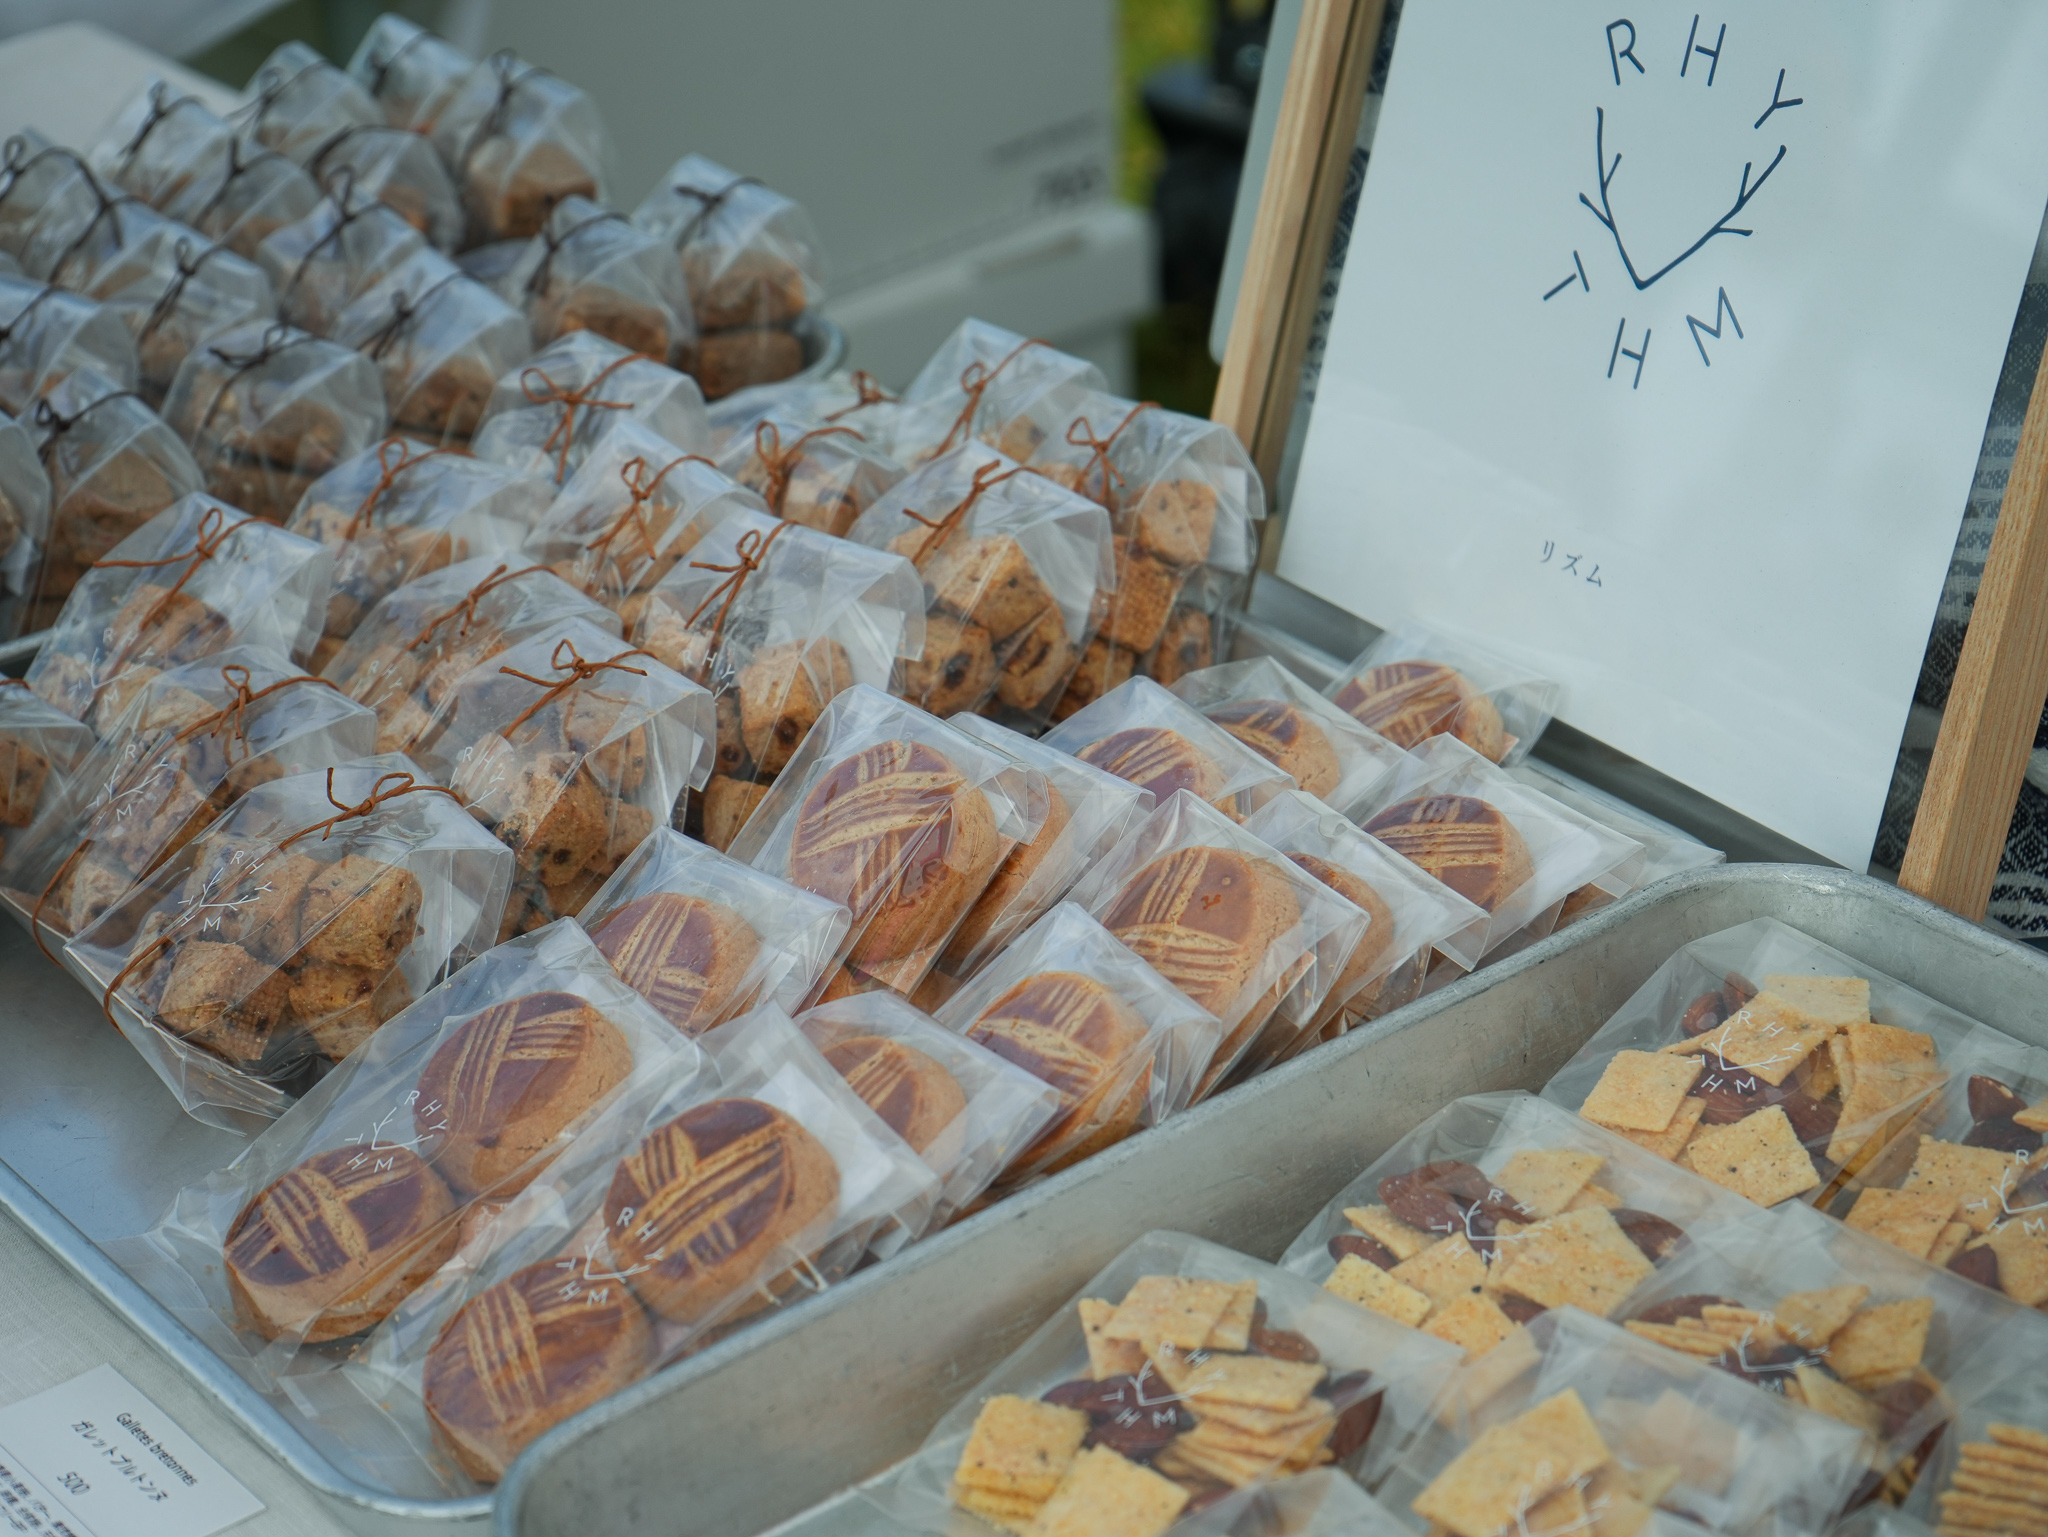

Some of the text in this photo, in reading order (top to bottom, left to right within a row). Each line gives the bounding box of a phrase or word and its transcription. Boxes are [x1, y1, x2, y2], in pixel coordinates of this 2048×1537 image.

[1540, 540, 1602, 588] リズム
[57, 1471, 90, 1496] 500
[71, 1420, 169, 1503] ガレットブルトンヌ
